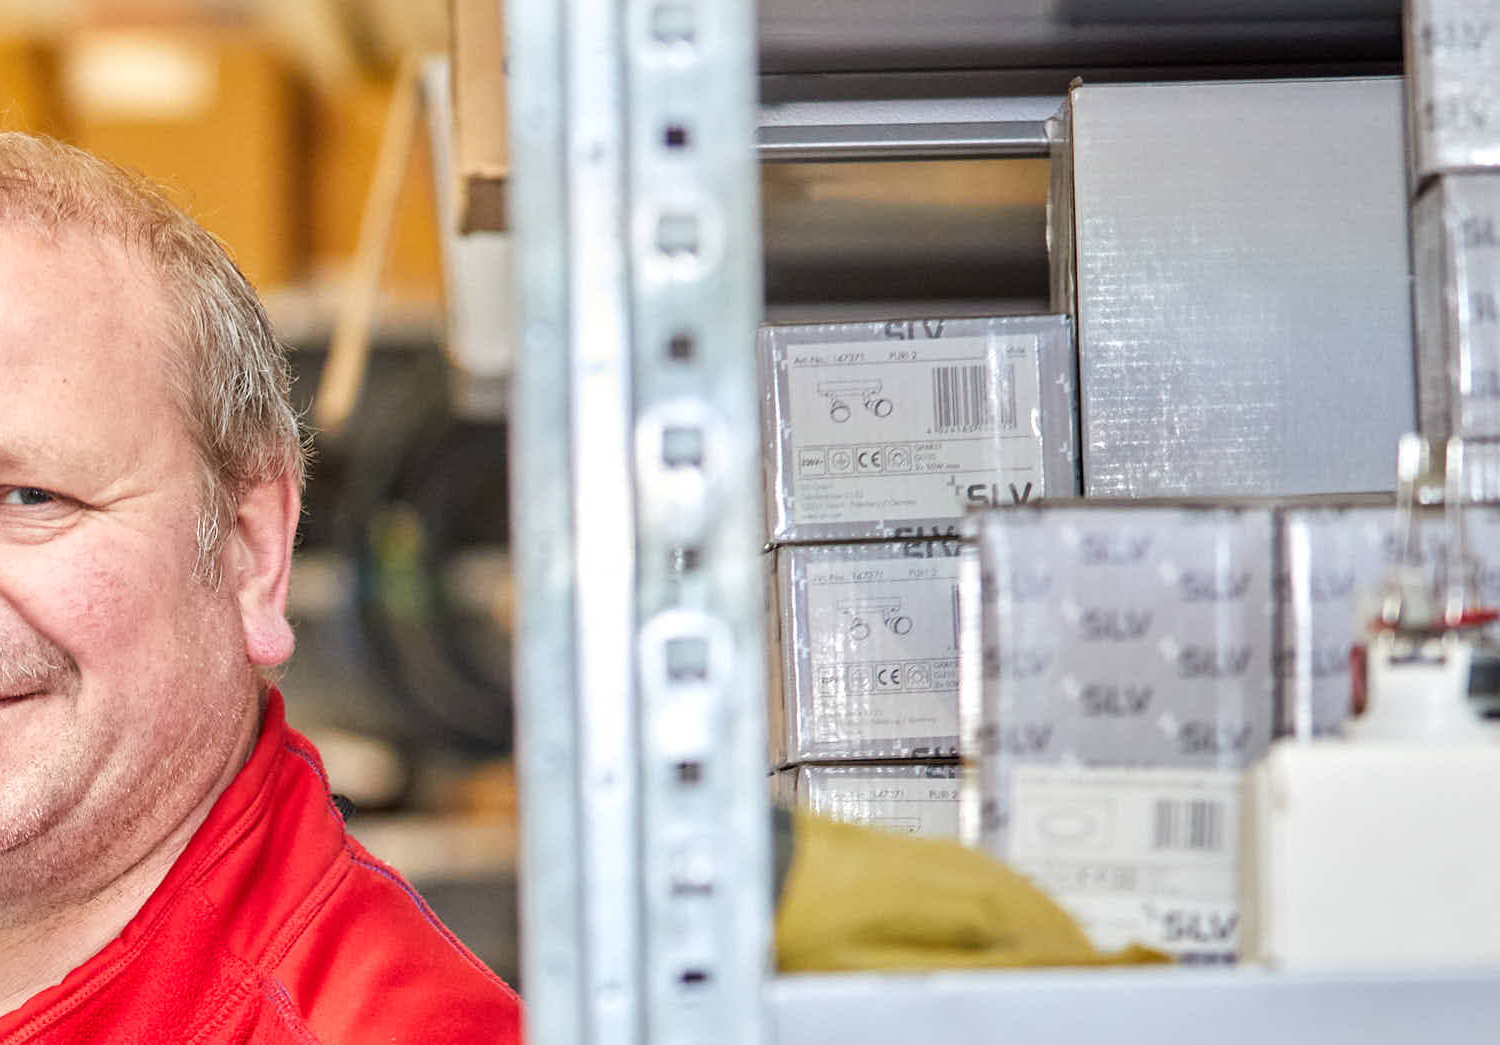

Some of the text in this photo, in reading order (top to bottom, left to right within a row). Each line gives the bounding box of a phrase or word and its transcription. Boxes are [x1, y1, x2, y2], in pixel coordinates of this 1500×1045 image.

[966, 481, 1034, 505] SLV
[1079, 607, 1153, 641] SLV
[1177, 645, 1253, 679] SLV
[1079, 683, 1153, 716] SLV
[1177, 720, 1253, 754] SLV
[1163, 909, 1238, 942] SLV
